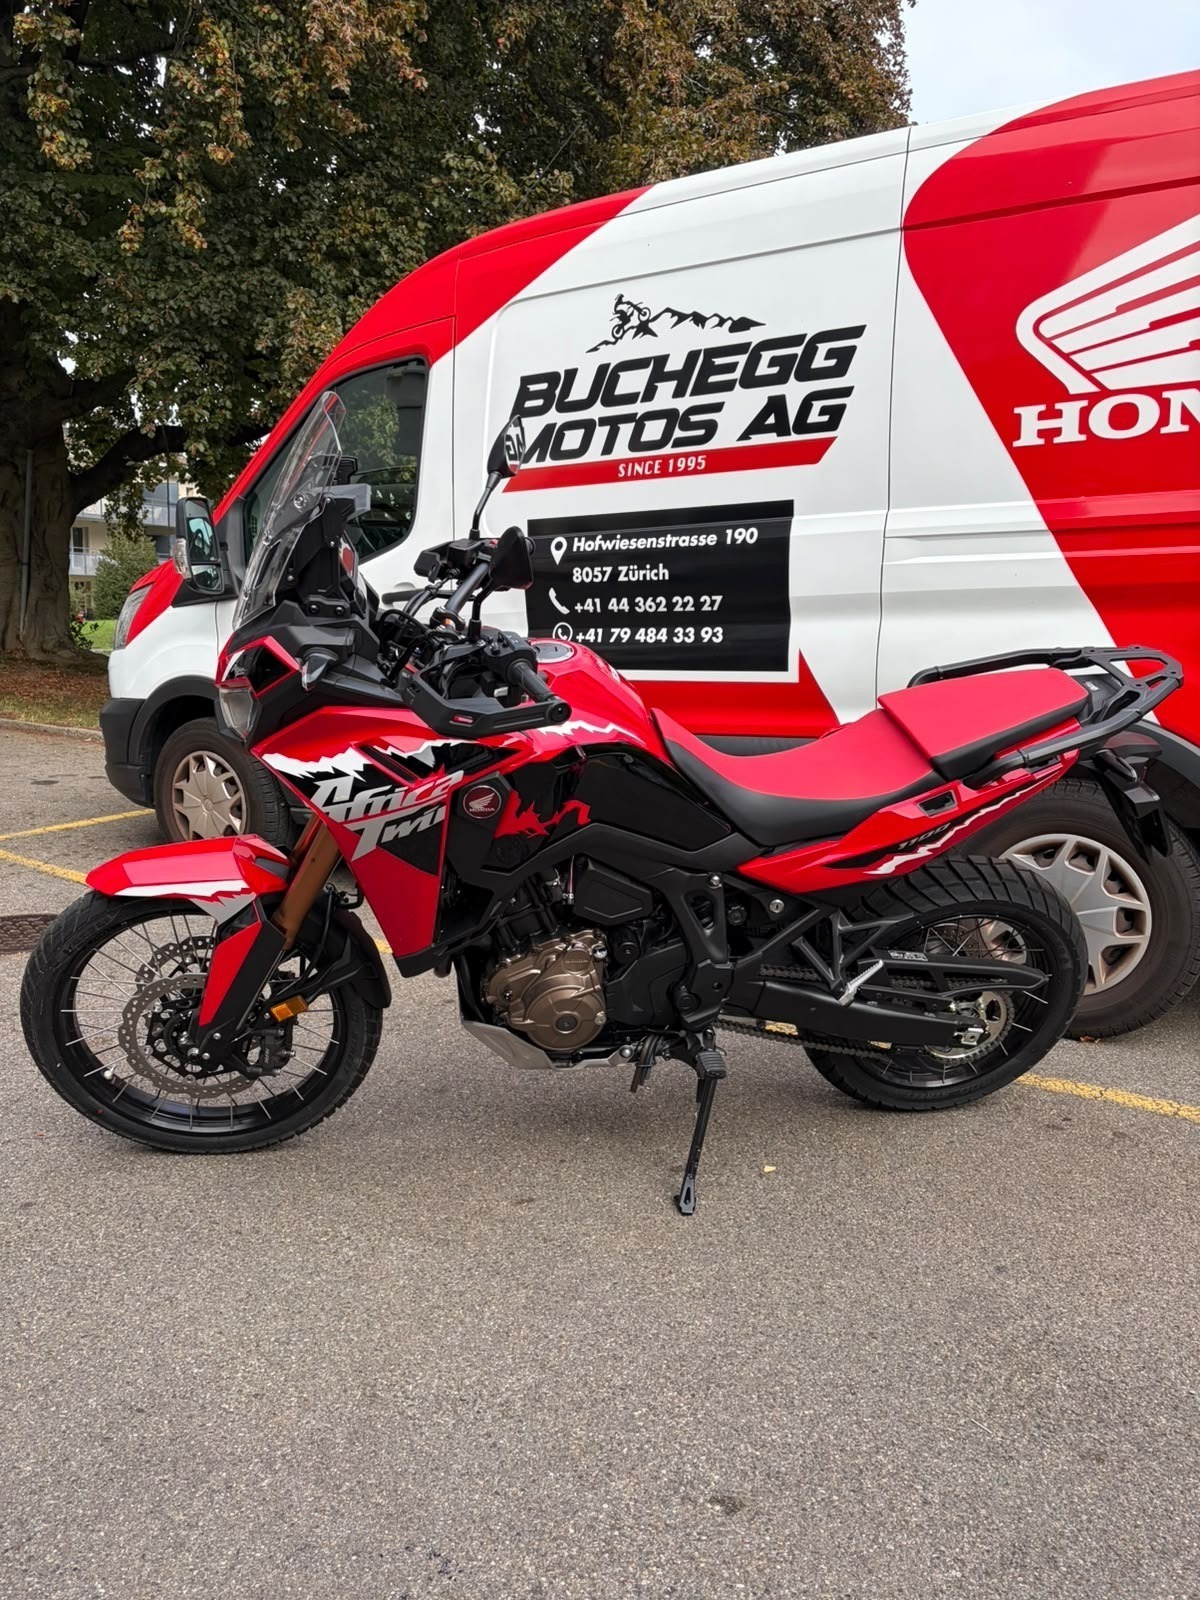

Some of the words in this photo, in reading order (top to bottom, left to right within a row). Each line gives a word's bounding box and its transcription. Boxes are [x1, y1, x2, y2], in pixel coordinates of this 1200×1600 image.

[511, 324, 867, 418] BUCHEGG
[521, 402, 725, 464] MOTOS
[736, 386, 855, 442] AG
[617, 459, 662, 478] SINCE
[666, 455, 708, 473] 1995
[572, 533, 718, 551] Hofwiesenstrasse
[725, 527, 759, 545] 190
[572, 566, 613, 583] 8057
[617, 563, 670, 582] Zürich
[574, 597, 601, 613] +41
[607, 597, 630, 613] 44
[634, 596, 668, 613] 362
[671, 595, 696, 612] 22
[700, 595, 723, 612] 27
[575, 627, 603, 643] +41
[609, 627, 631, 643] 79
[634, 627, 668, 643] 484
[672, 626, 696, 643] 33
[700, 626, 724, 643] 93
[310, 769, 465, 823] Africa
